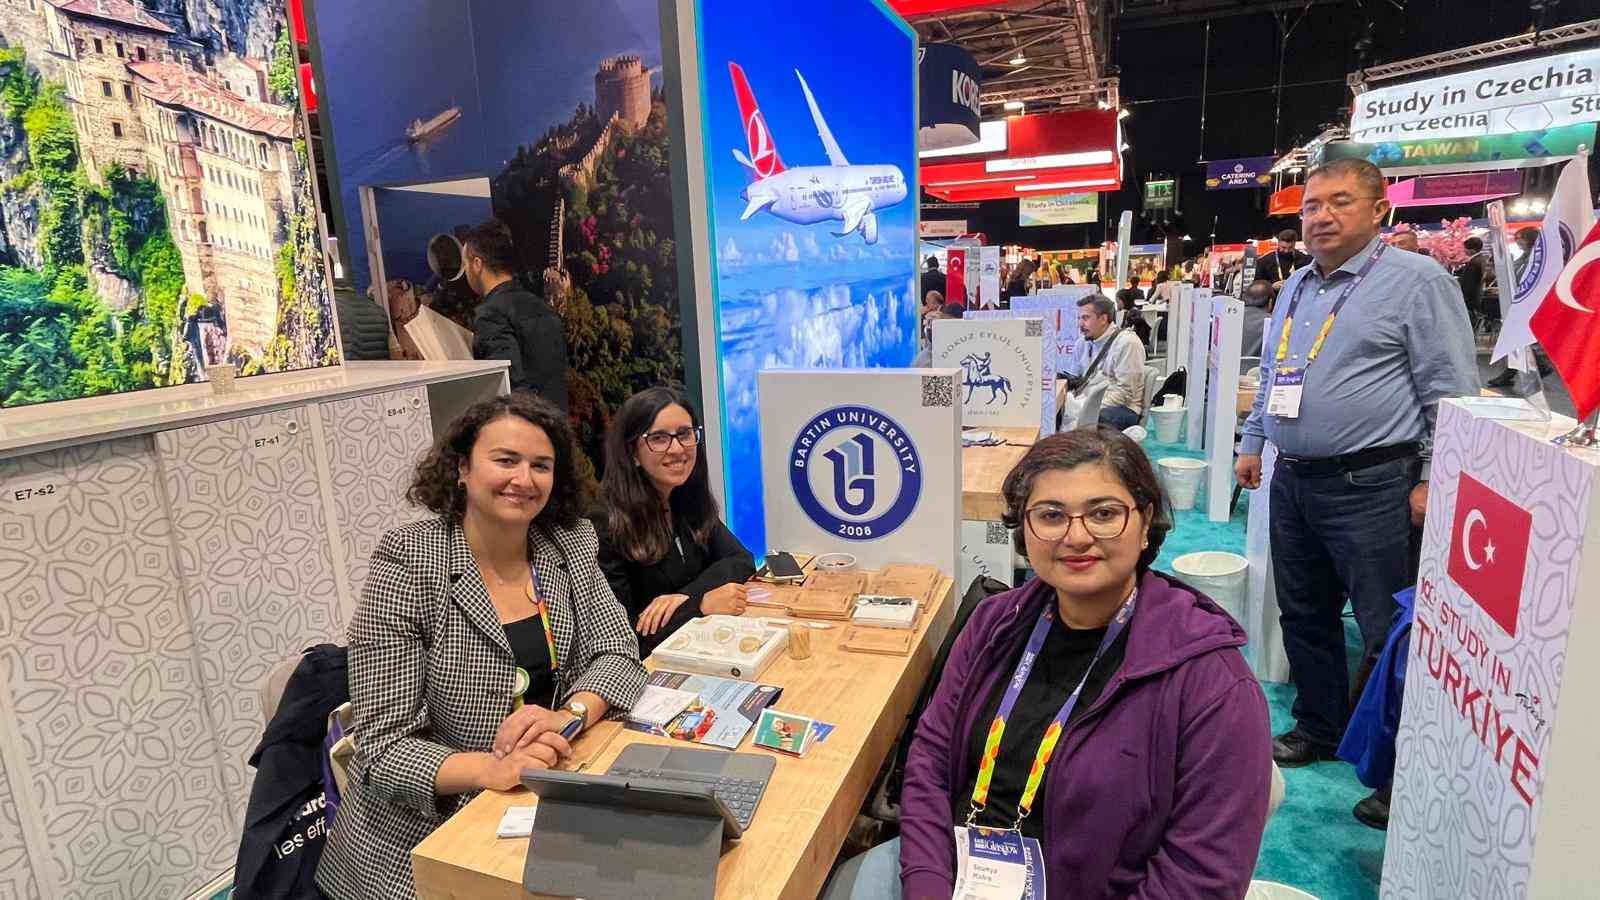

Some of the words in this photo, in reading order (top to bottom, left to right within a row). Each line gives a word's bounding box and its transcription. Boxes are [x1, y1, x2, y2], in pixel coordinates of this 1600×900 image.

[1365, 93, 1434, 119] Study
[1442, 86, 1466, 106] in
[1475, 64, 1593, 100] Czechia
[1402, 140, 1479, 158] TAIWAN
[1221, 171, 1256, 180] CATERING
[941, 332, 974, 359] DOKUZ
[254, 435, 279, 447] E7-s1
[795, 417, 831, 468] BARTIN
[837, 411, 916, 473] UNIVERSITY
[14, 484, 55, 501] E7-s2
[839, 524, 872, 536] 2008
[1440, 601, 1490, 668] STUDY
[1492, 655, 1512, 696] IN
[1417, 615, 1540, 807] TÜRKİYE
[273, 833, 304, 860] les
